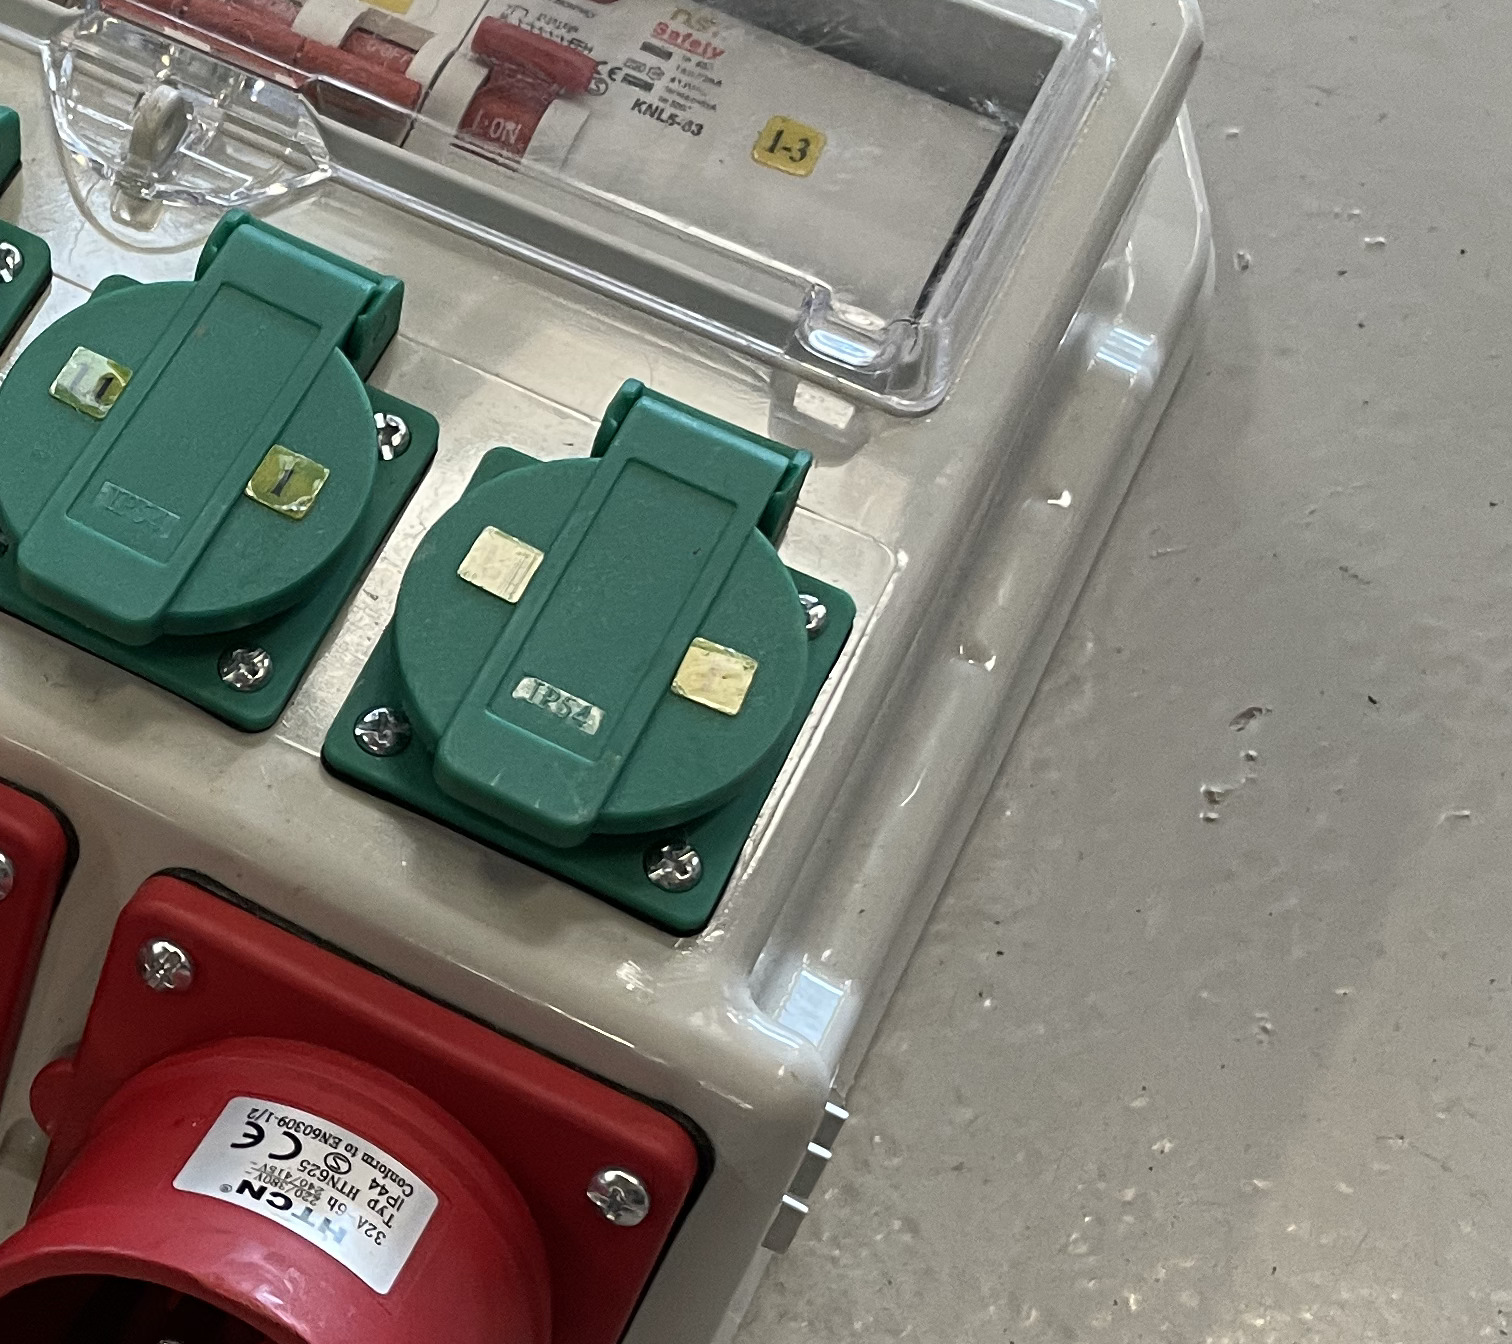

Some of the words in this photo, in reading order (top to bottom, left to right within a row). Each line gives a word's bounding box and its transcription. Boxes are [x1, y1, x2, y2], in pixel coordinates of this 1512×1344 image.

[767, 129, 811, 163] 1-3
[271, 467, 297, 497] 1
[229, 1120, 303, 1161] CE
[246, 1107, 343, 1149] EN60309-1/2
[344, 1142, 359, 1158] to
[296, 1159, 361, 1201] HTN625
[361, 1152, 414, 1198] Conform
[366, 1197, 395, 1229] Typ
[368, 1177, 405, 1213] IP44
